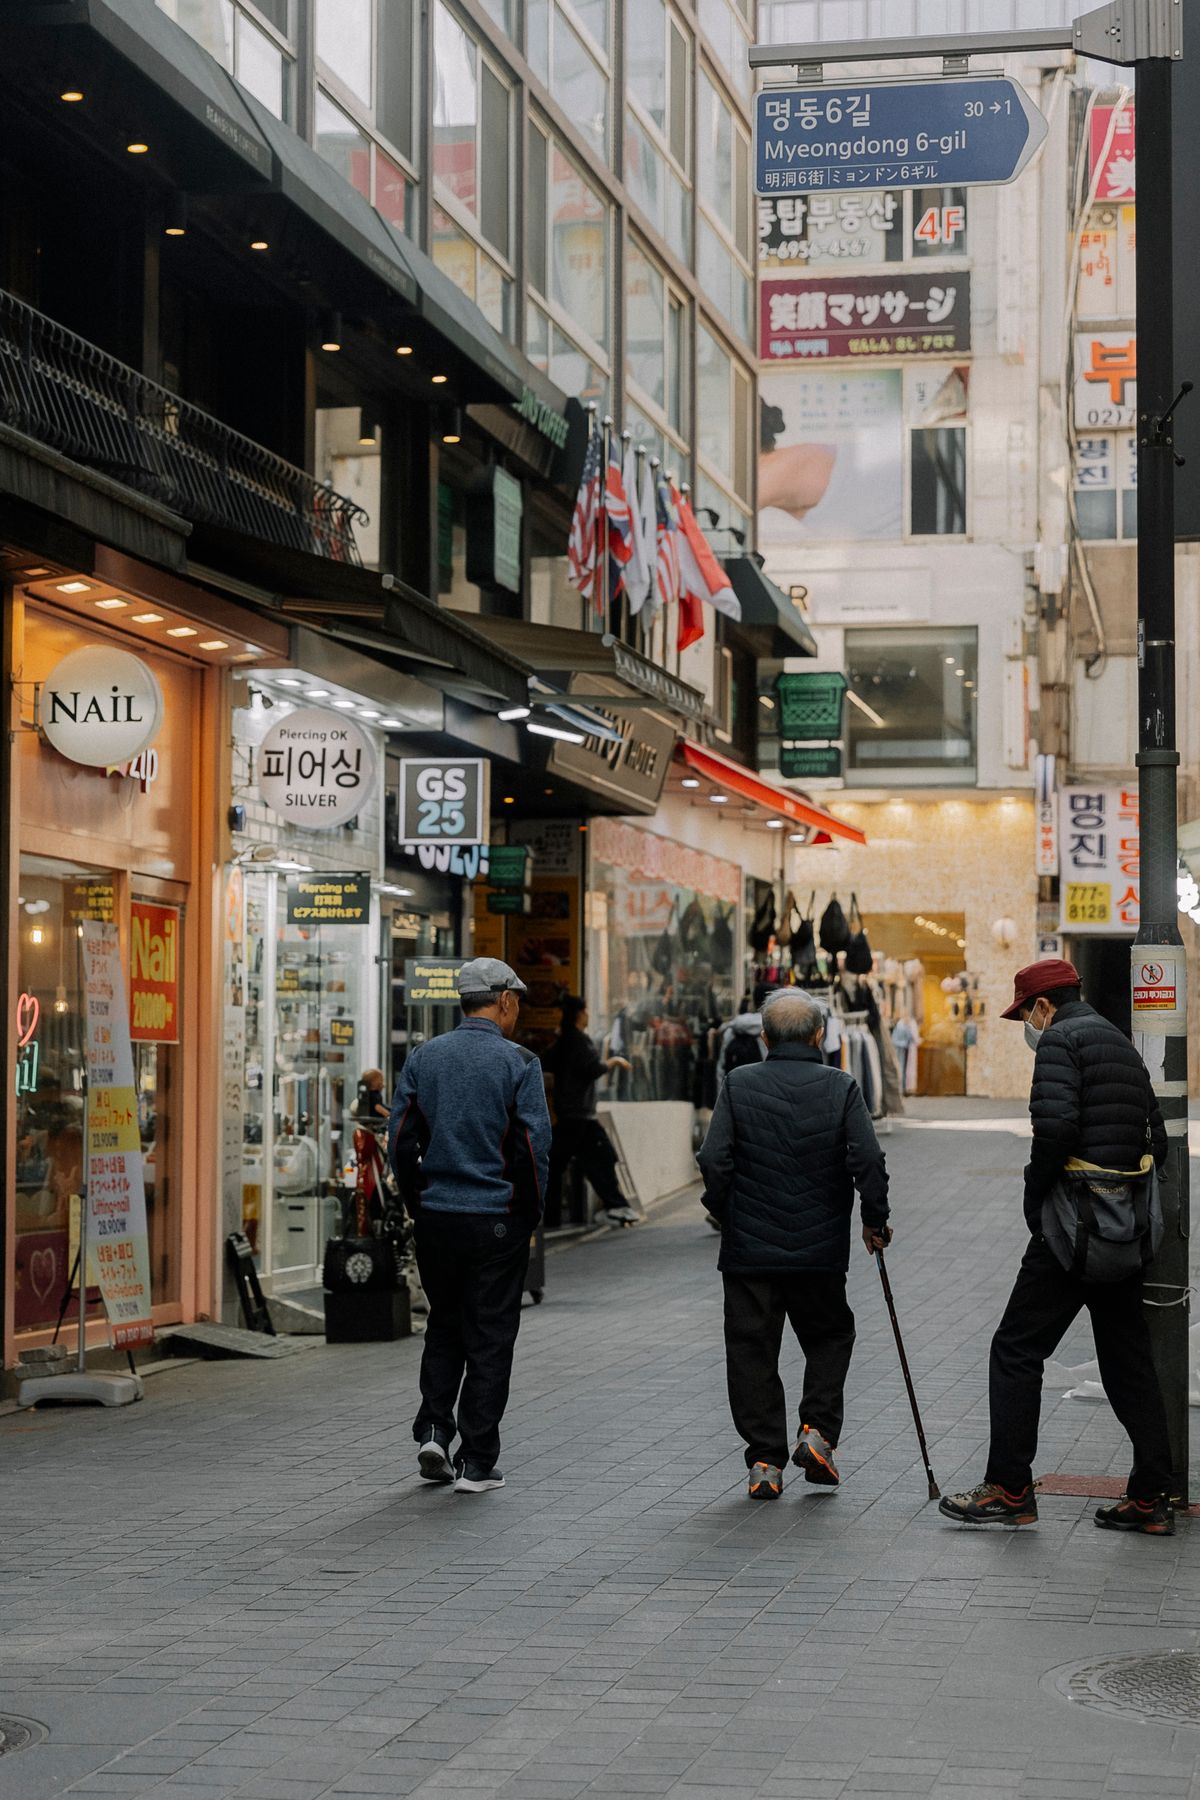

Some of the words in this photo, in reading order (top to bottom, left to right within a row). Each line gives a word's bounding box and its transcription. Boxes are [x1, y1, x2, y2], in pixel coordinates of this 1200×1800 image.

[765, 94, 871, 131] 명동6길
[964, 102, 984, 117] 30
[765, 135, 909, 162] Myeongdong
[915, 130, 967, 155] 6-gil
[765, 170, 824, 187] 明洞6街
[832, 165, 938, 184] ミョンドン6ギル
[914, 206, 965, 244] 4F
[279, 729, 327, 743] Piercing
[330, 730, 348, 741] OK
[262, 747, 362, 789] 피어싱
[416, 767, 467, 801] GS
[285, 793, 338, 807] SILVER
[417, 801, 465, 835] 25
[1069, 793, 1107, 868] 명진
[131, 916, 176, 984] Nail
